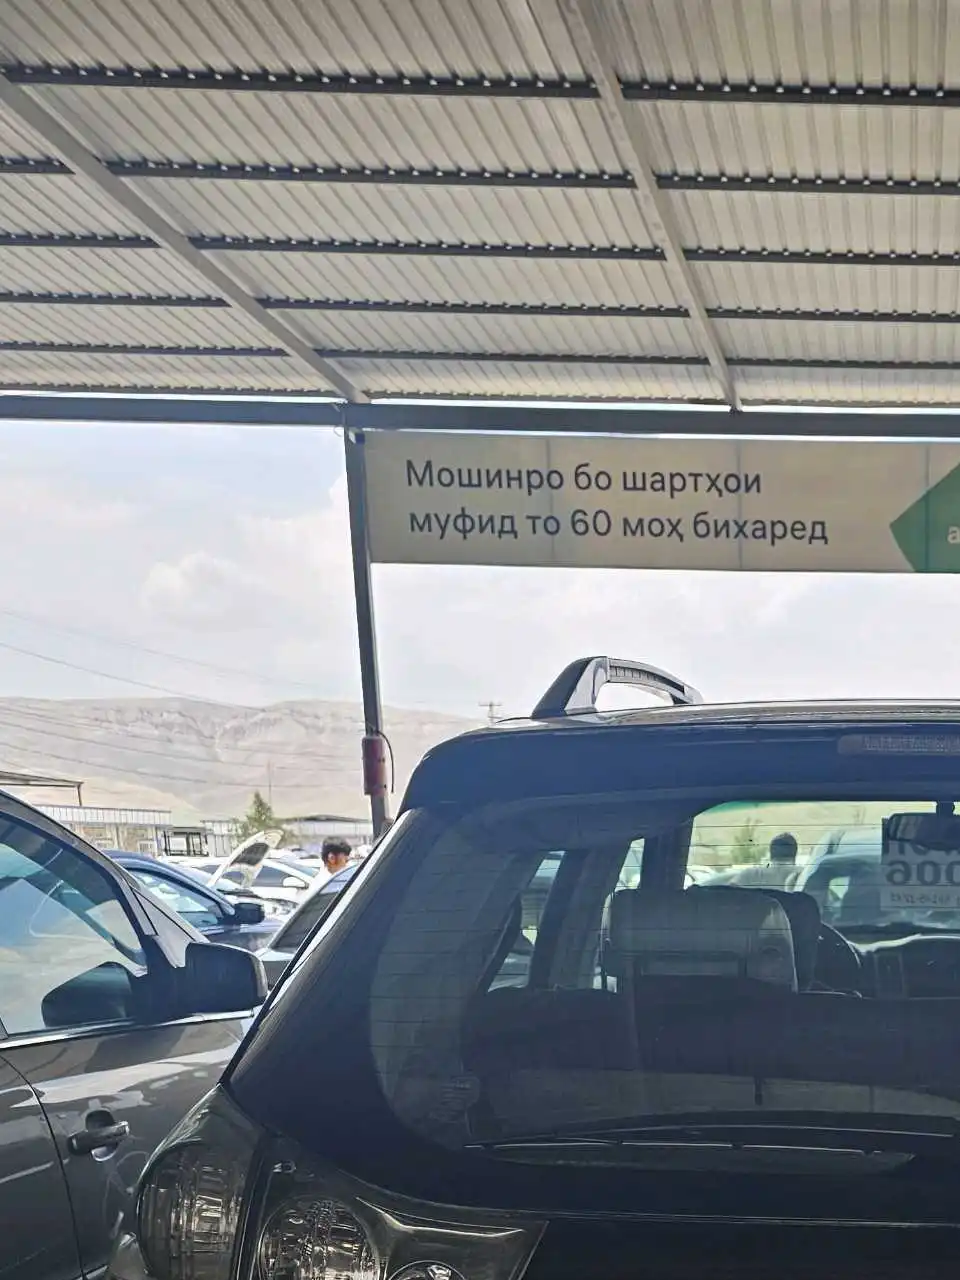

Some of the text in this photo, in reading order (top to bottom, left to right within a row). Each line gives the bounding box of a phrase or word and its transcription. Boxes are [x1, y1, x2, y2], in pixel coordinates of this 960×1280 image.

[406, 459, 761, 499] Мошинро бо шартҳои
[409, 506, 828, 546] муфид то 60 моҳ бихаред
